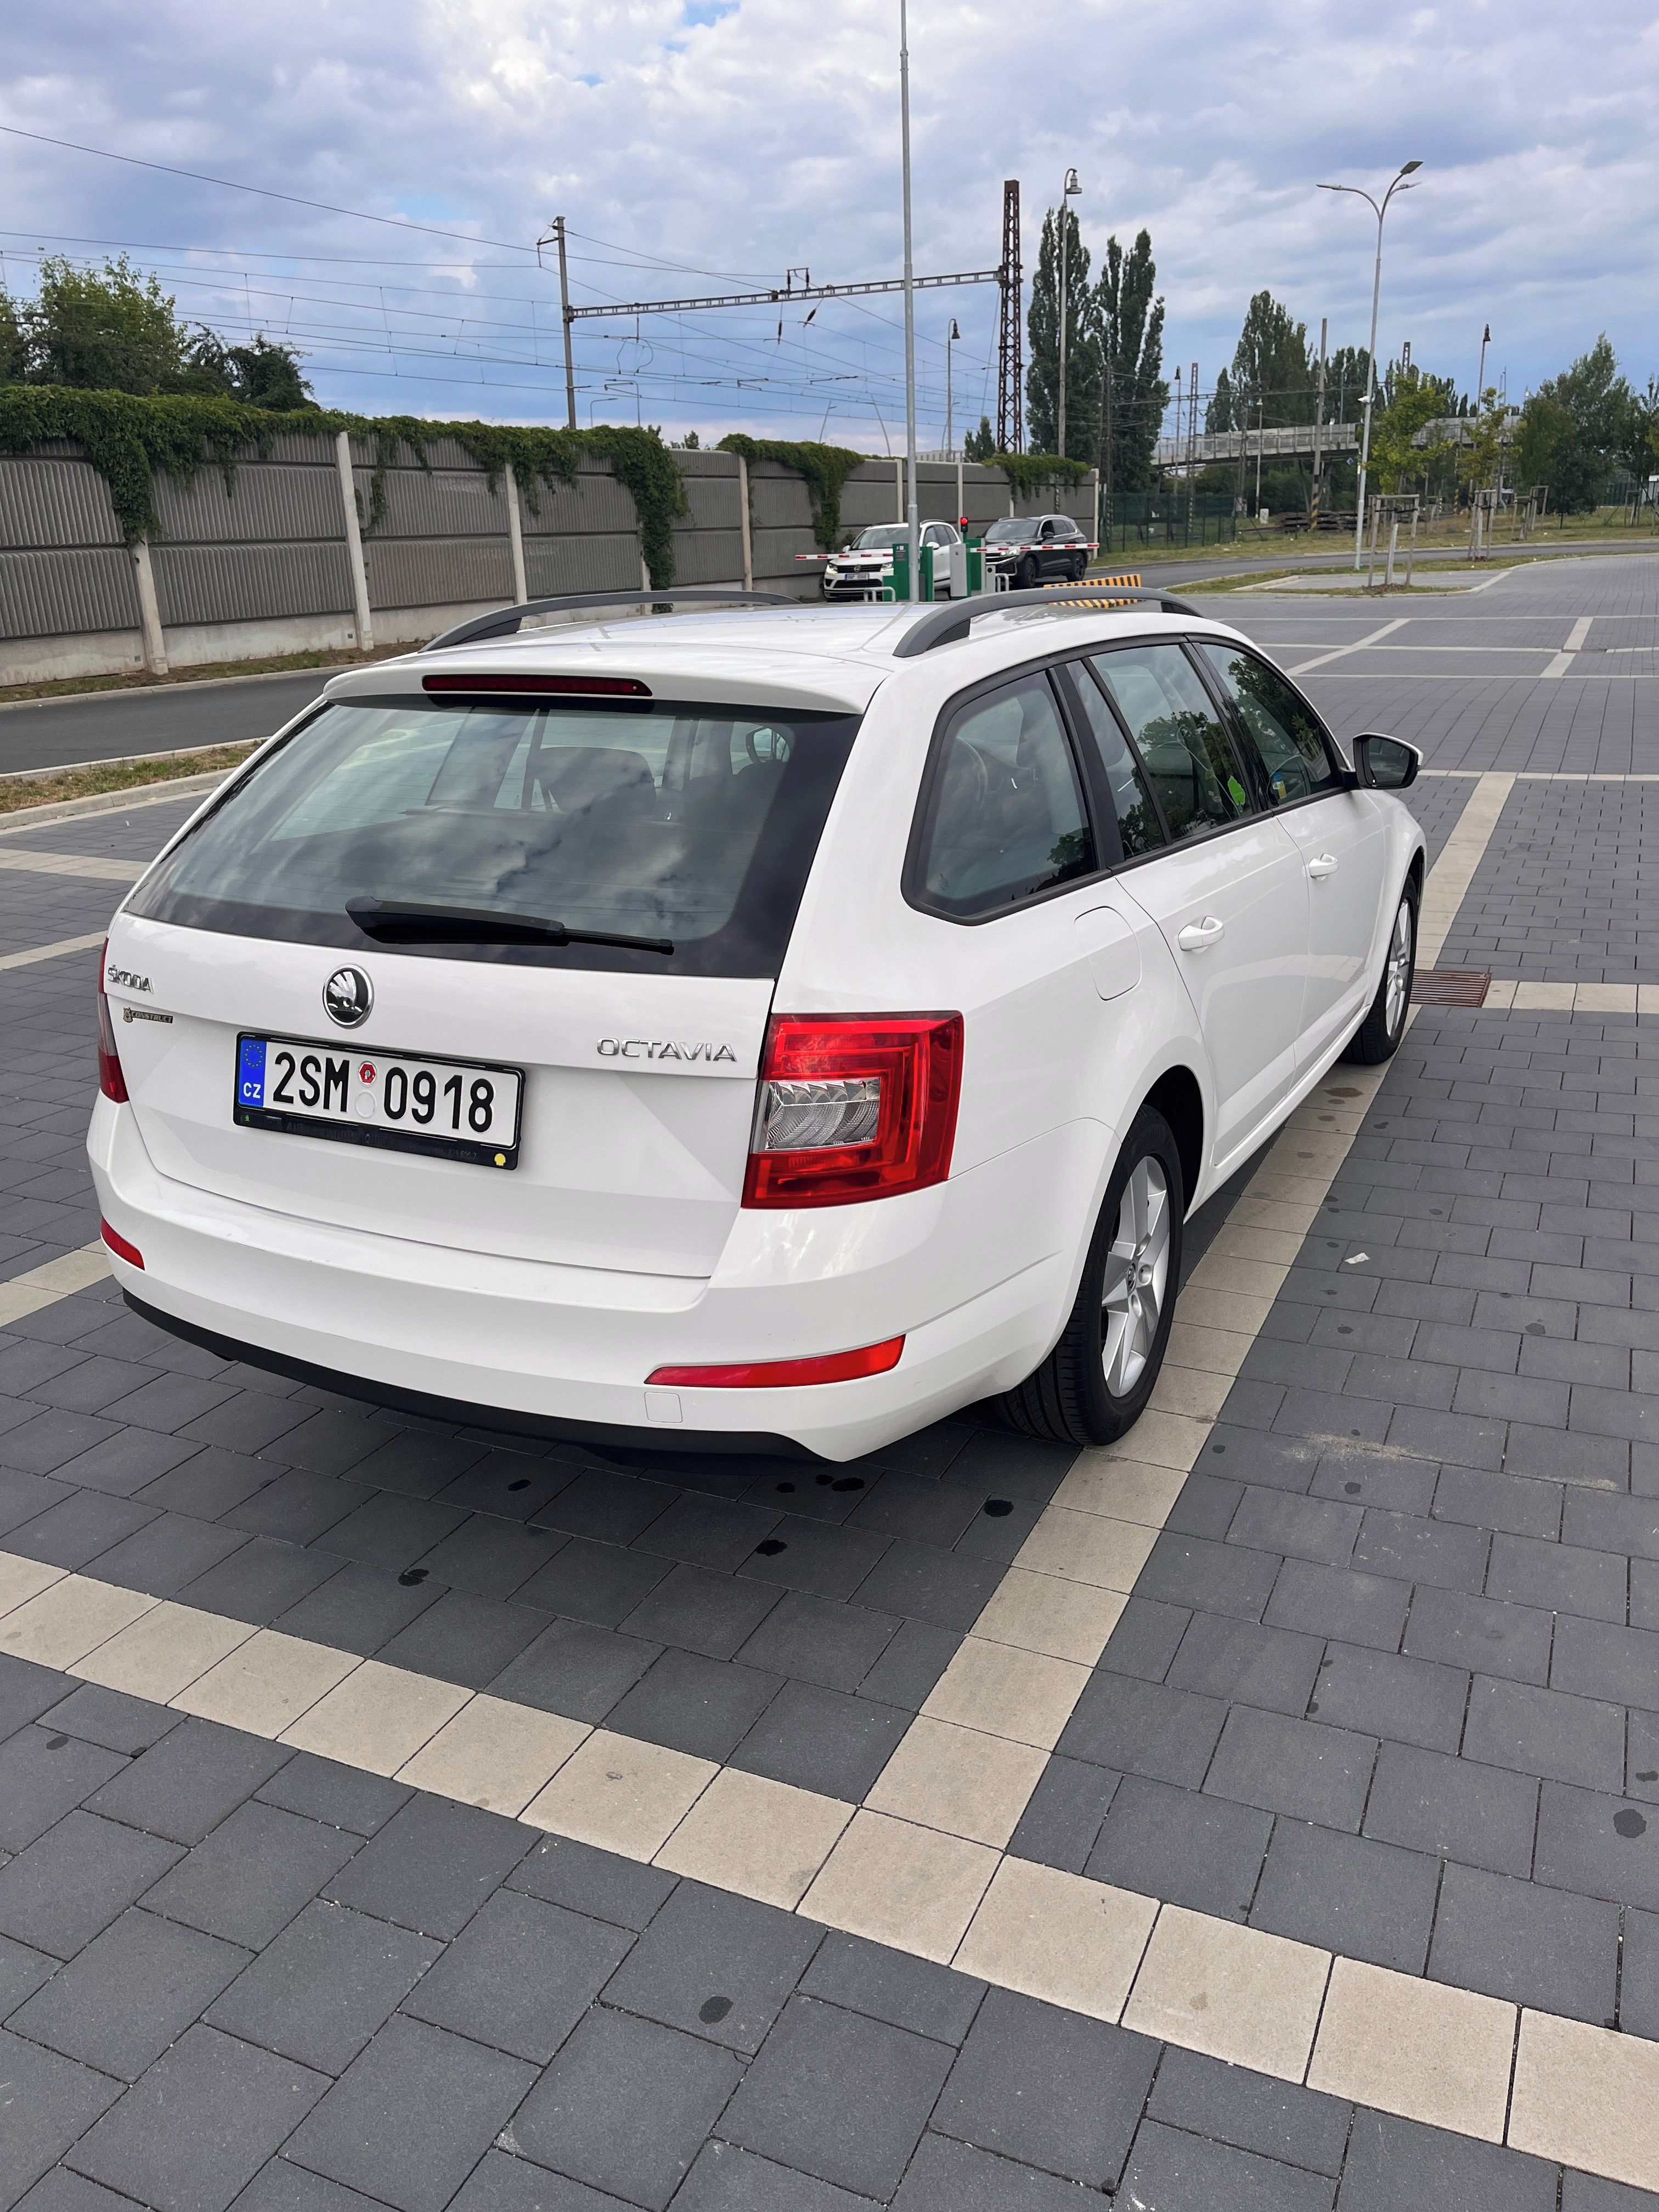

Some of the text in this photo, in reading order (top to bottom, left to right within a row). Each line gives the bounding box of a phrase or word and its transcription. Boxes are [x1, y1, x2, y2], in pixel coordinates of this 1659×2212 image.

[108, 964, 154, 994] ŠKODA
[597, 1037, 737, 1062] OCTAVIA
[243, 1082, 261, 1099] CZ
[273, 1052, 495, 1133] 2SM 0918
